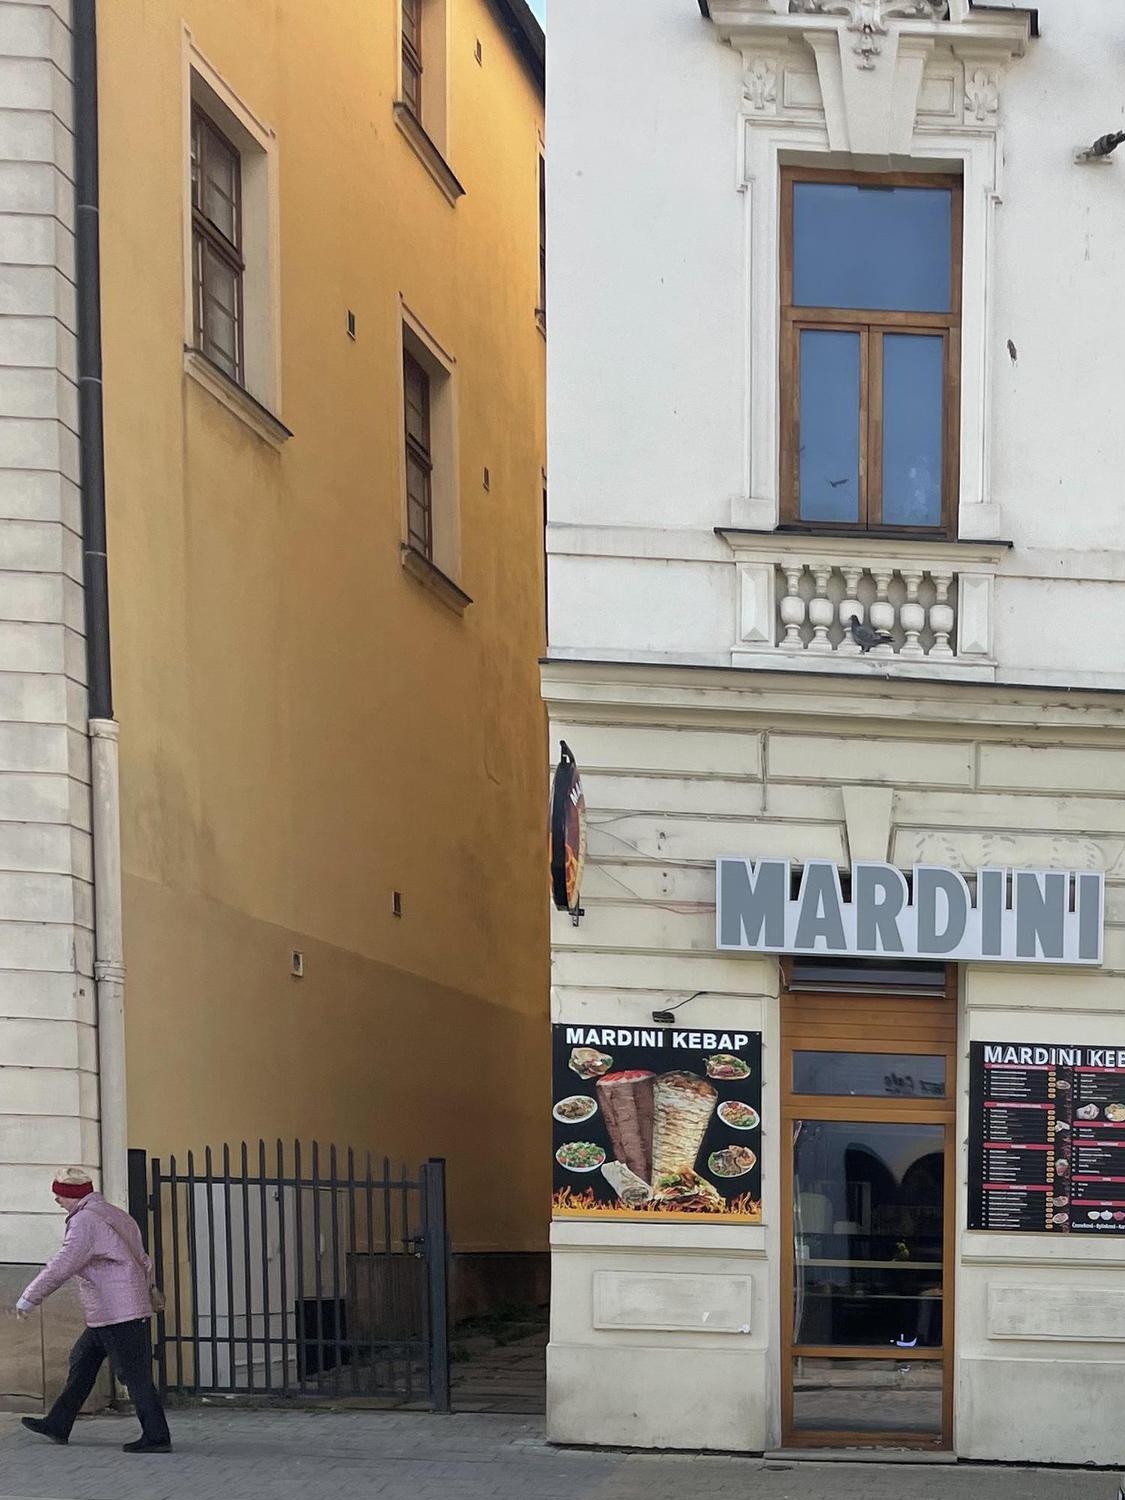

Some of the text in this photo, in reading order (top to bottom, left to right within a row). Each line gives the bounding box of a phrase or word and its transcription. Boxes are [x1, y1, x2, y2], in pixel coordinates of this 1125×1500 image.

[719, 859, 1101, 960] MARDINI
[566, 1027, 749, 1050] MARDINI KEBAP
[984, 1045, 1081, 1066] MARDINI
